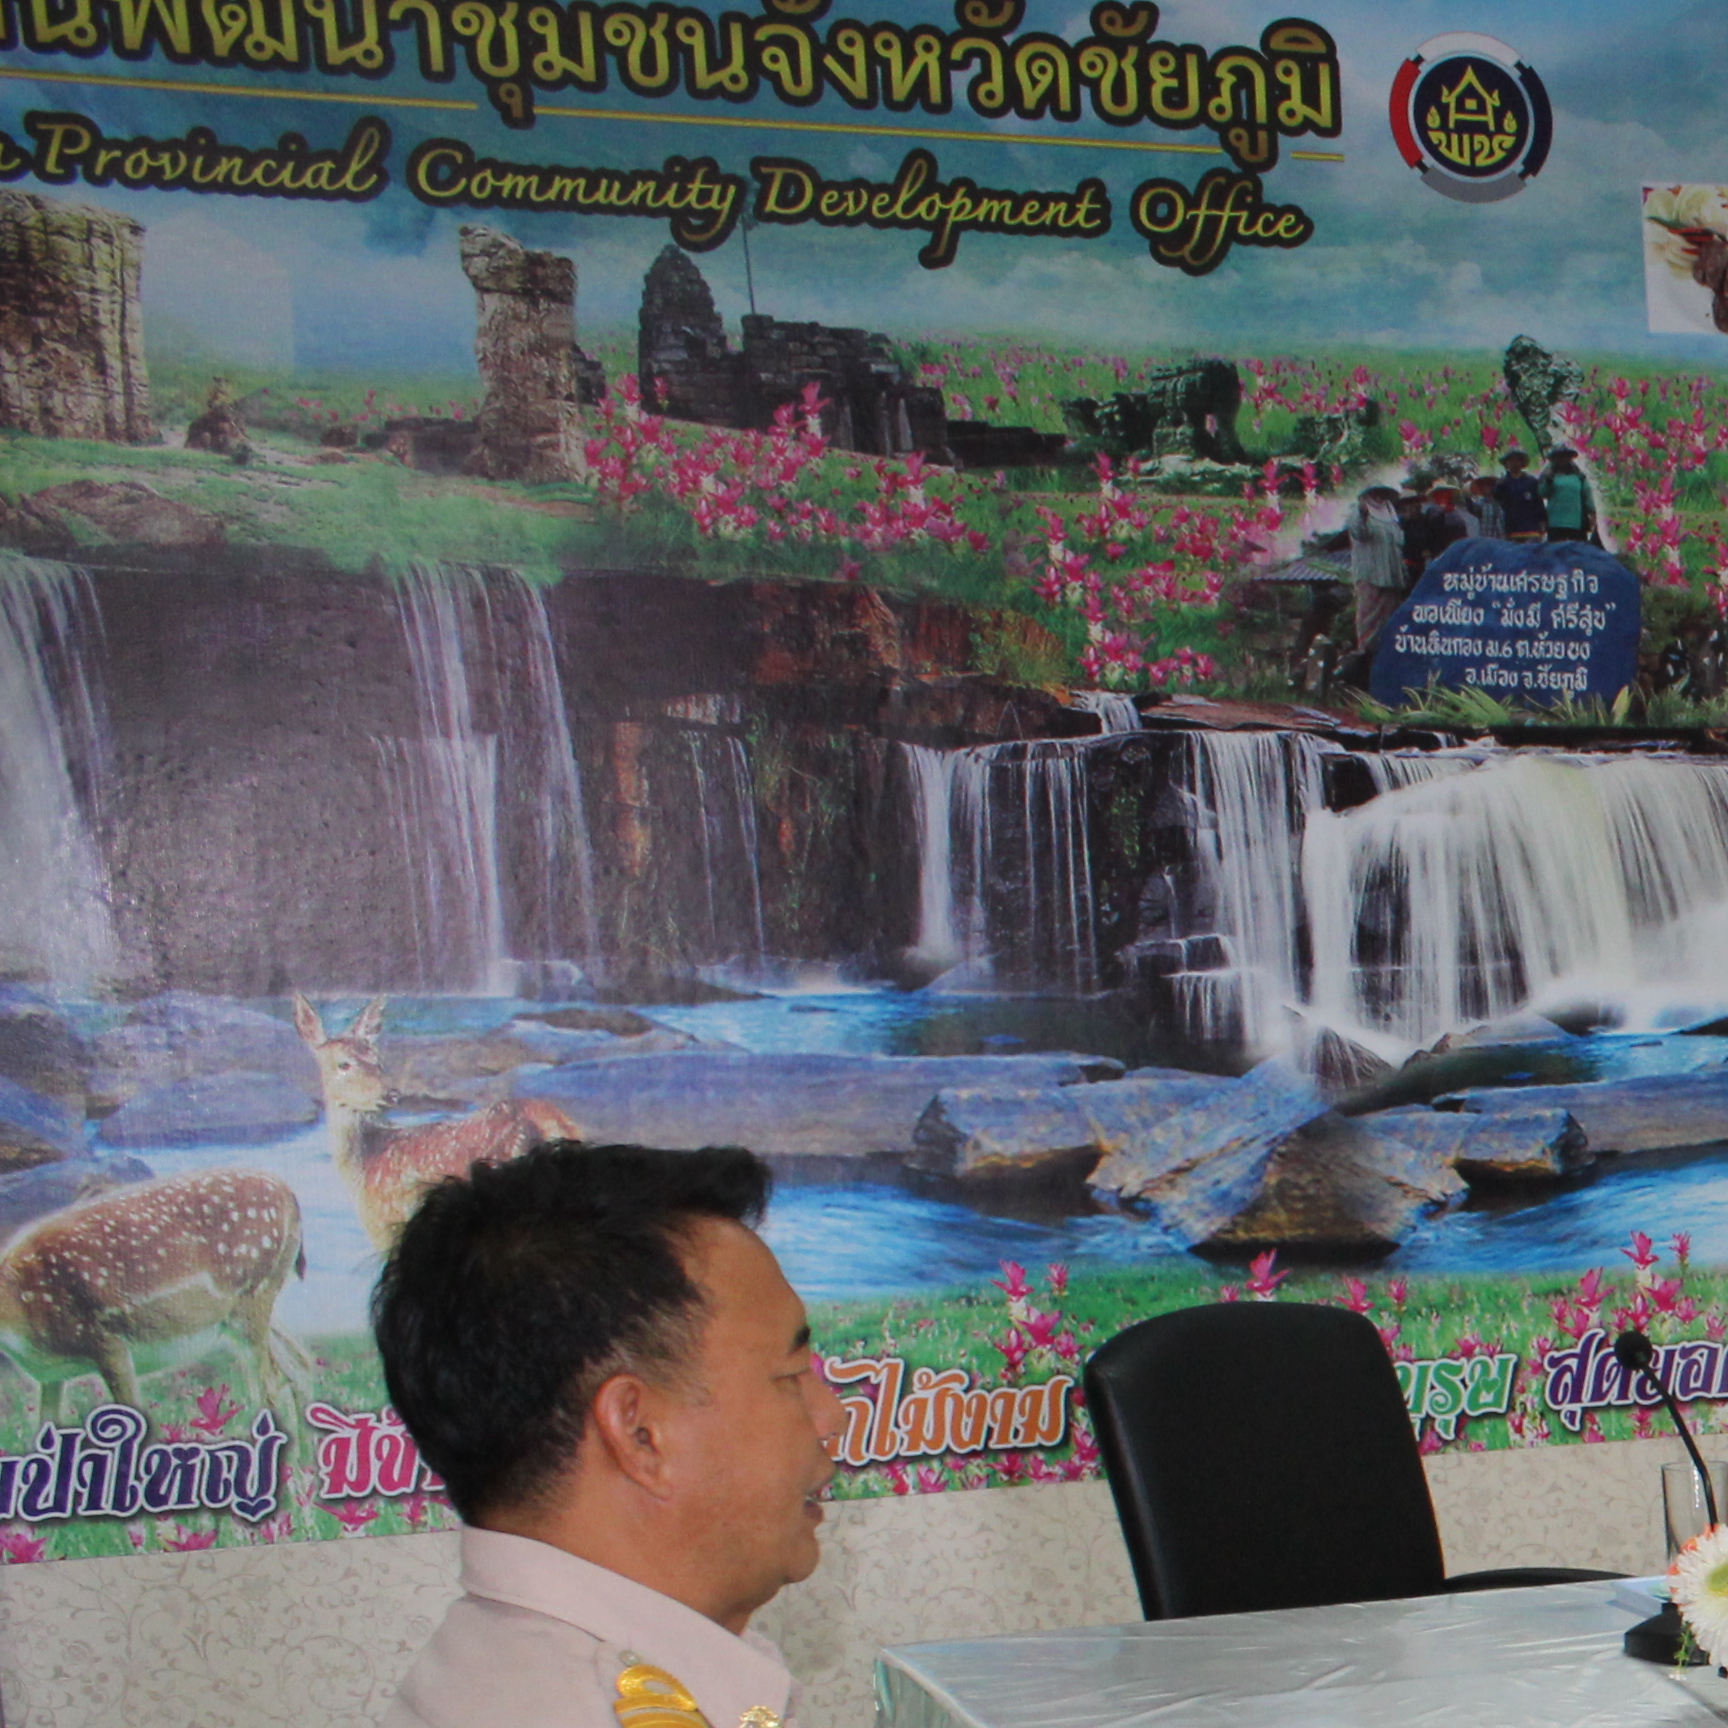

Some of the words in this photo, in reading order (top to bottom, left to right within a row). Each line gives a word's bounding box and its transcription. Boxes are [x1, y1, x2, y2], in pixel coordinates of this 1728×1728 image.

[0, 0, 1334, 163] นพฒนาชุมชนจงหวัดชัยภูมิ
[36, 126, 378, 193] Provincial
[416, 147, 737, 243] Community
[759, 157, 1102, 258] Development
[1138, 176, 1305, 266] Office
[823, 1357, 1075, 1466] กไม้งาม
